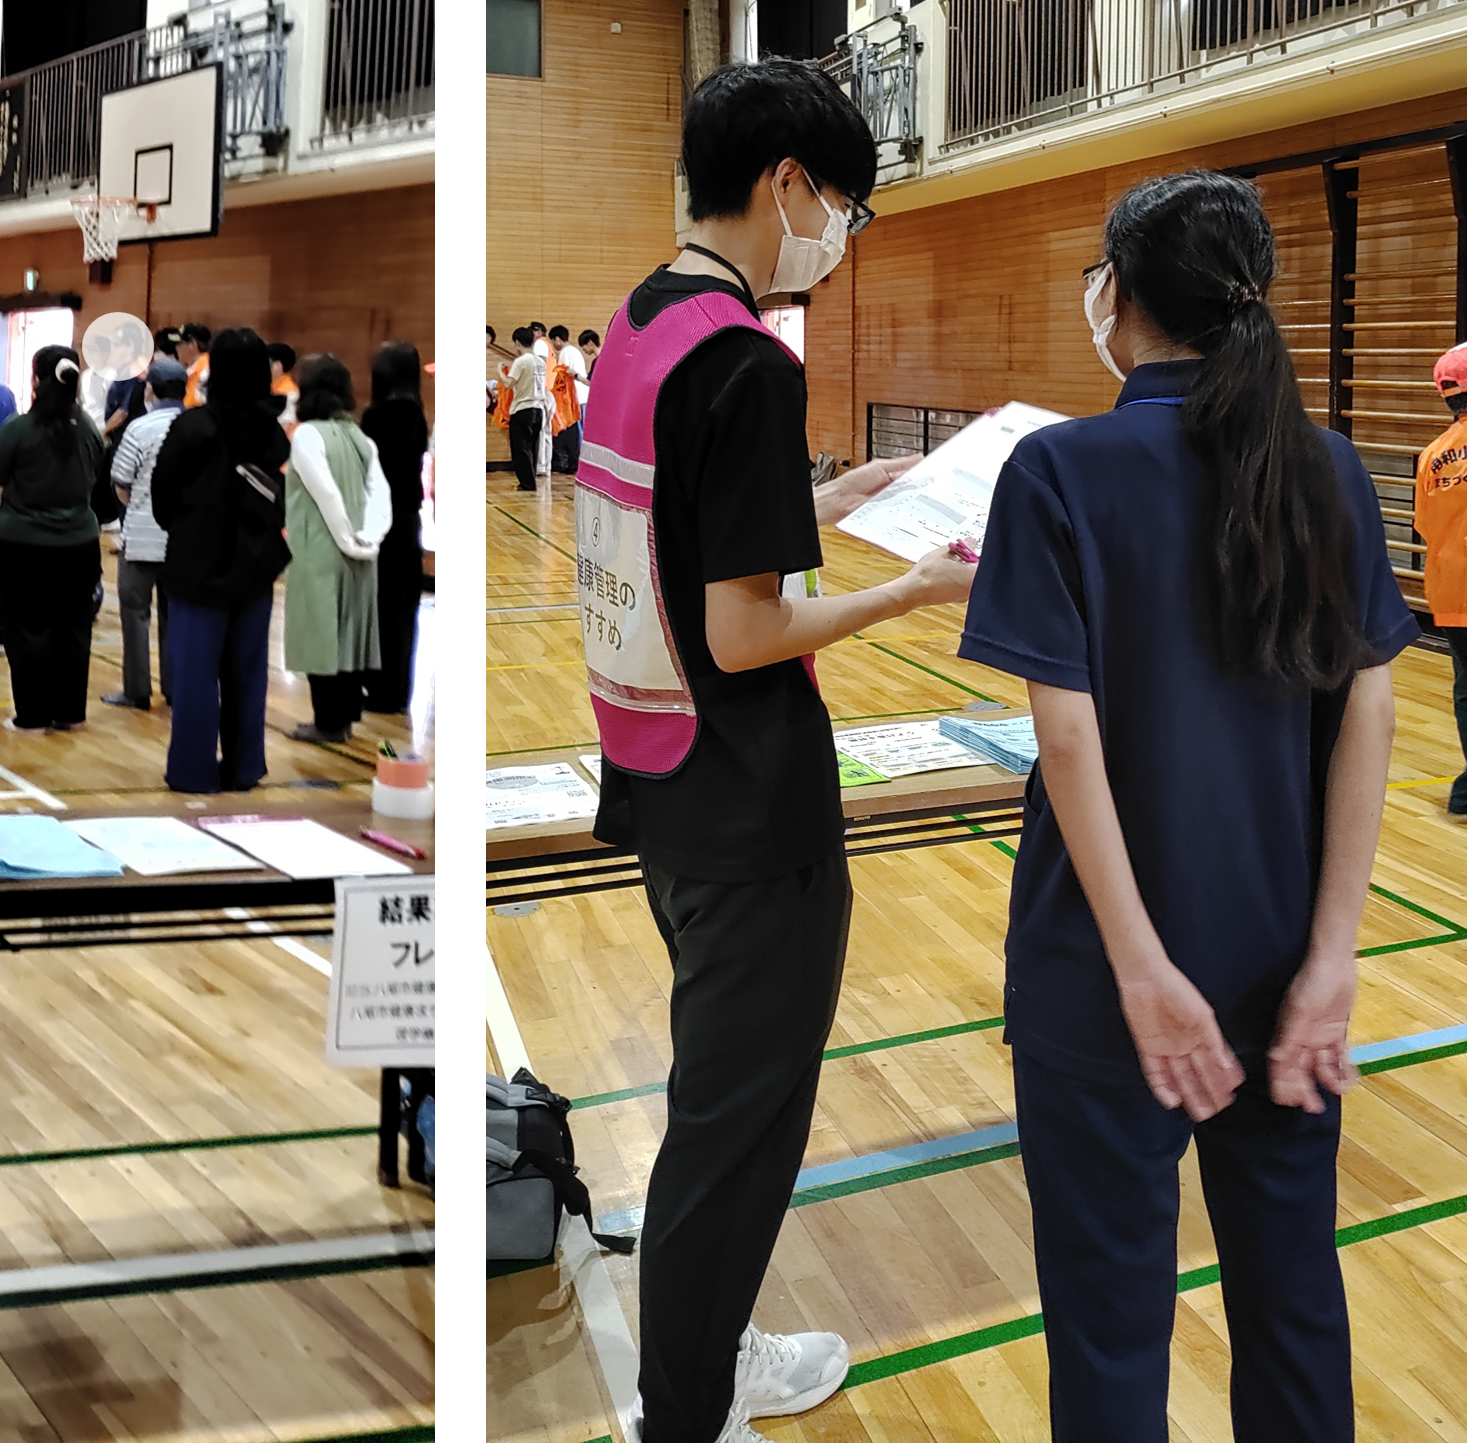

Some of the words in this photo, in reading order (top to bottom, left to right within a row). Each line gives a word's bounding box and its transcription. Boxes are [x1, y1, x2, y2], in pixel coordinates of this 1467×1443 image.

[584, 602, 622, 651] すすめ
[378, 894, 431, 925] 結果
[390, 940, 435, 968] フレ
